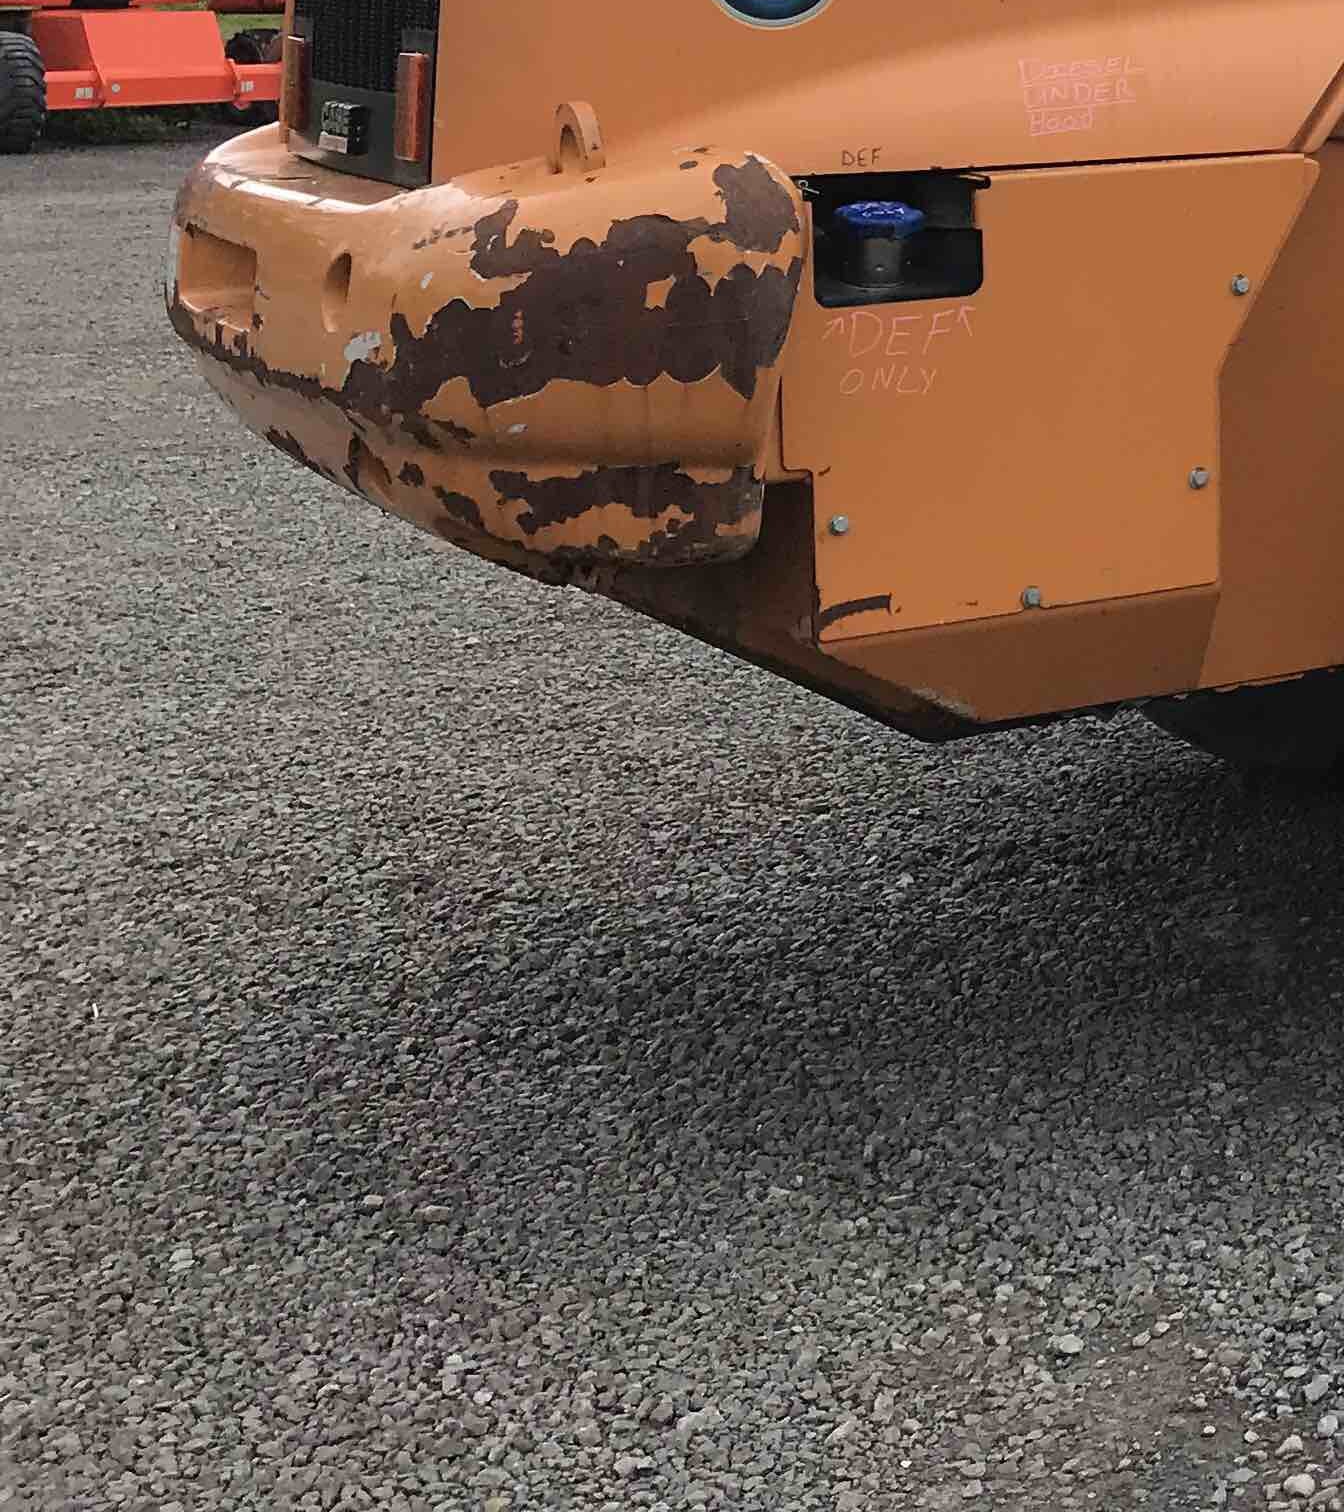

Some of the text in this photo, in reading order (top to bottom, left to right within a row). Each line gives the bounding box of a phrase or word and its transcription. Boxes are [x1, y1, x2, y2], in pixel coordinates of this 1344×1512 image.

[1023, 77, 1137, 105] UNDER
[841, 148, 882, 168] DEF
[848, 309, 956, 359] DEF
[839, 361, 938, 395] ONLY
